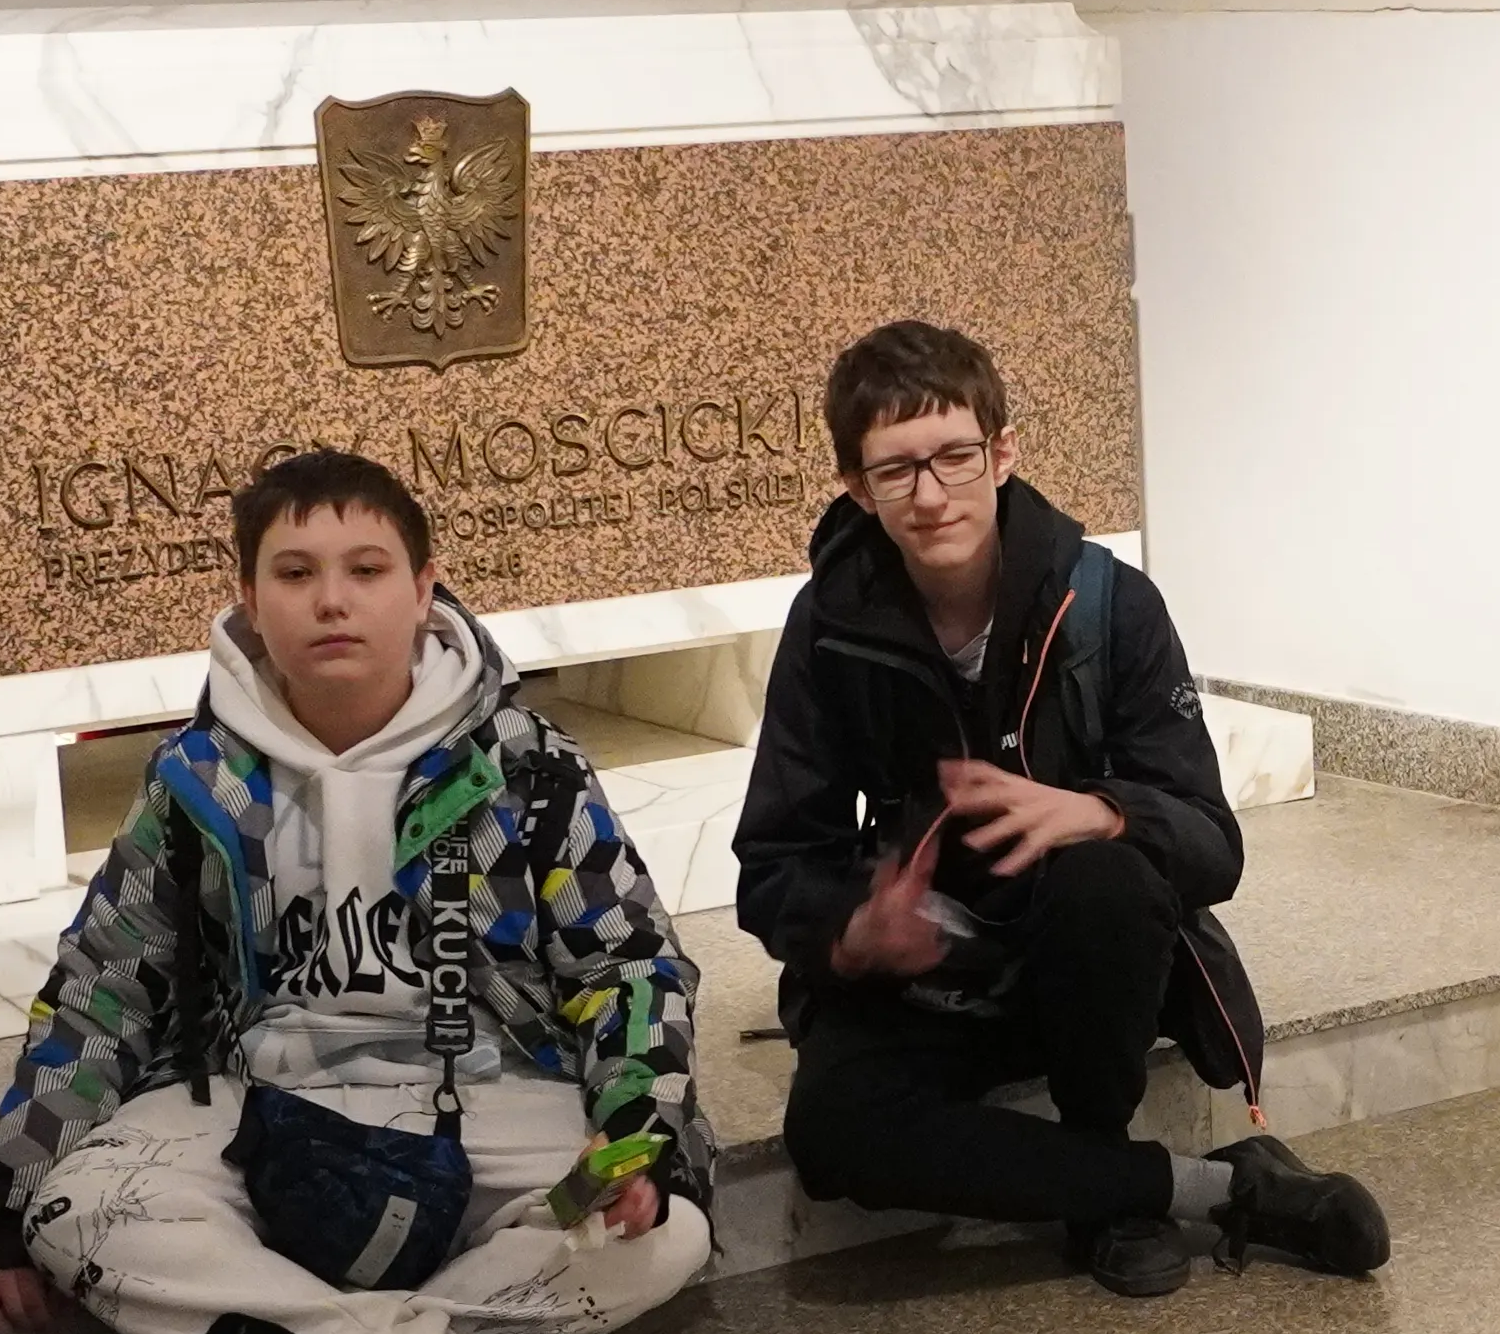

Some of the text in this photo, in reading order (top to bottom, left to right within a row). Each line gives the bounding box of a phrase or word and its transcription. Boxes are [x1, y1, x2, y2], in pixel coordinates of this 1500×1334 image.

[43, 473, 806, 590] PREZYDEN POSPOLITEJ POLSKIEJ
